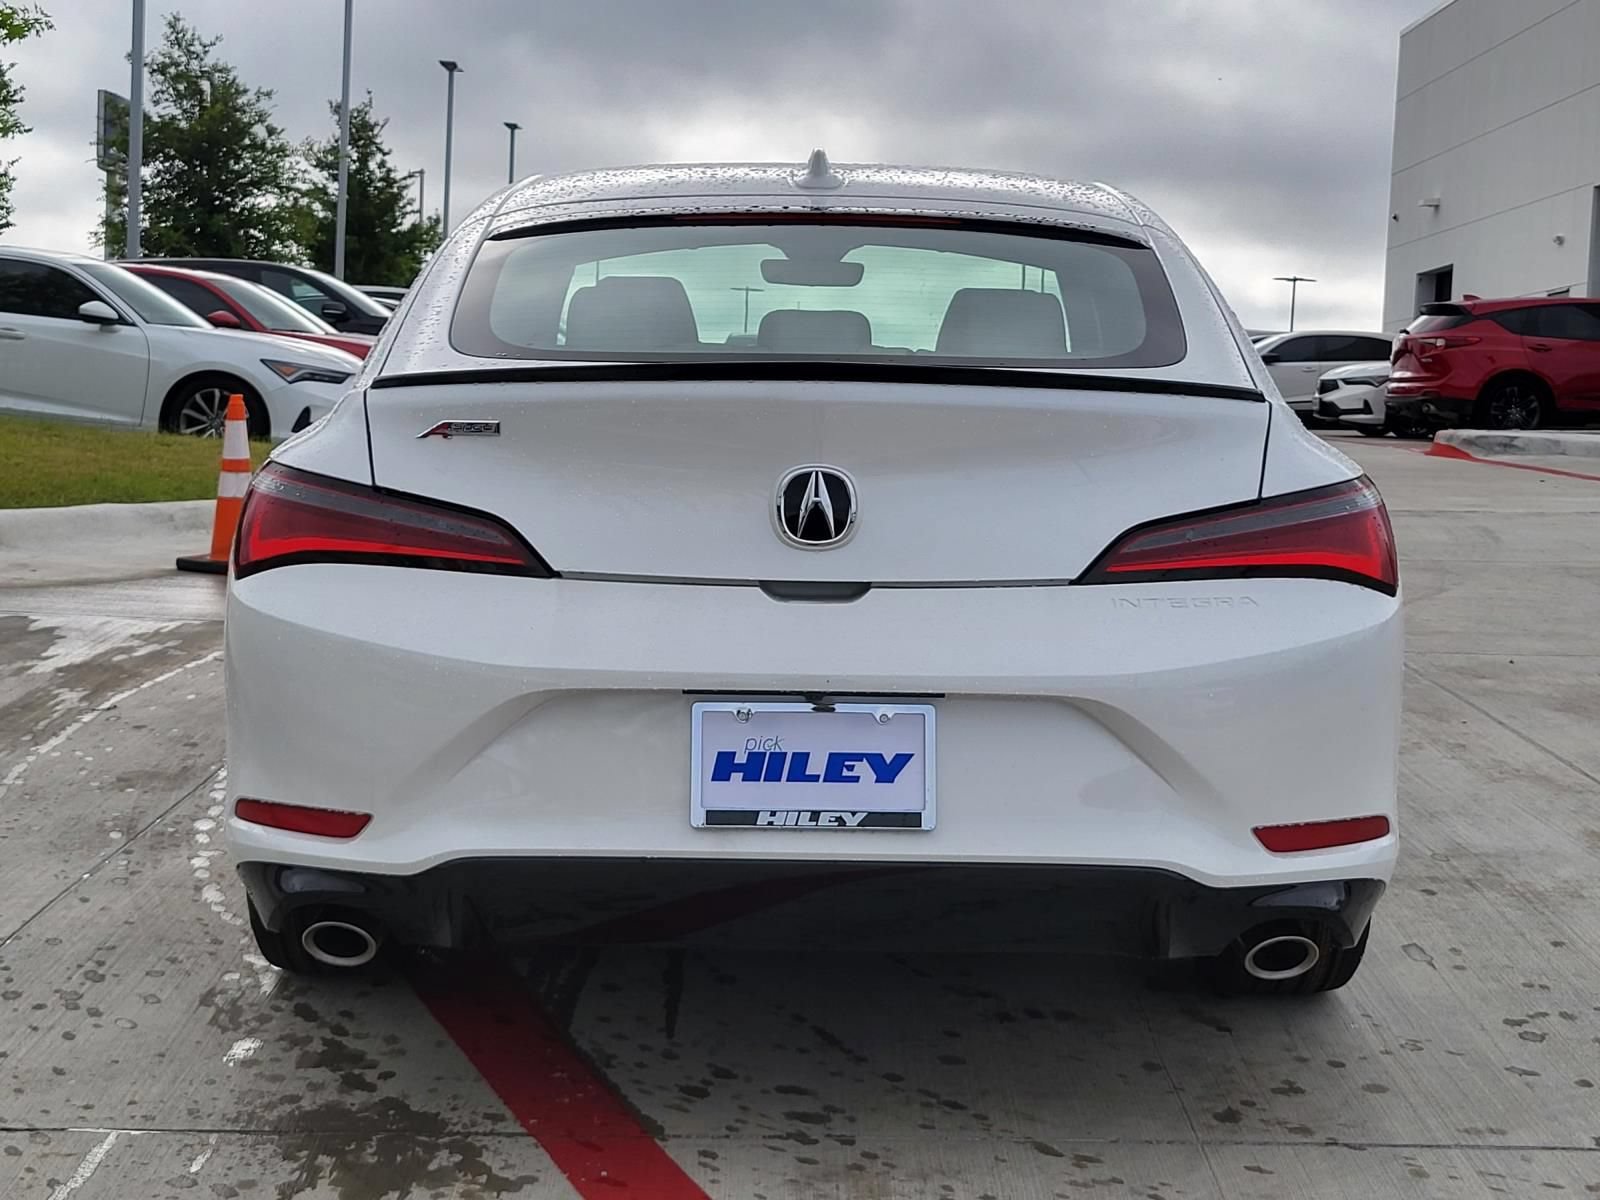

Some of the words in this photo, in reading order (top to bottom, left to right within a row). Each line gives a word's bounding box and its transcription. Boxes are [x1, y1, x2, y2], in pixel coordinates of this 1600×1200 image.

[1111, 596, 1260, 608] INTEGRA
[744, 735, 784, 753] pick
[711, 751, 915, 784] HILEY
[756, 811, 868, 827] HILEY
